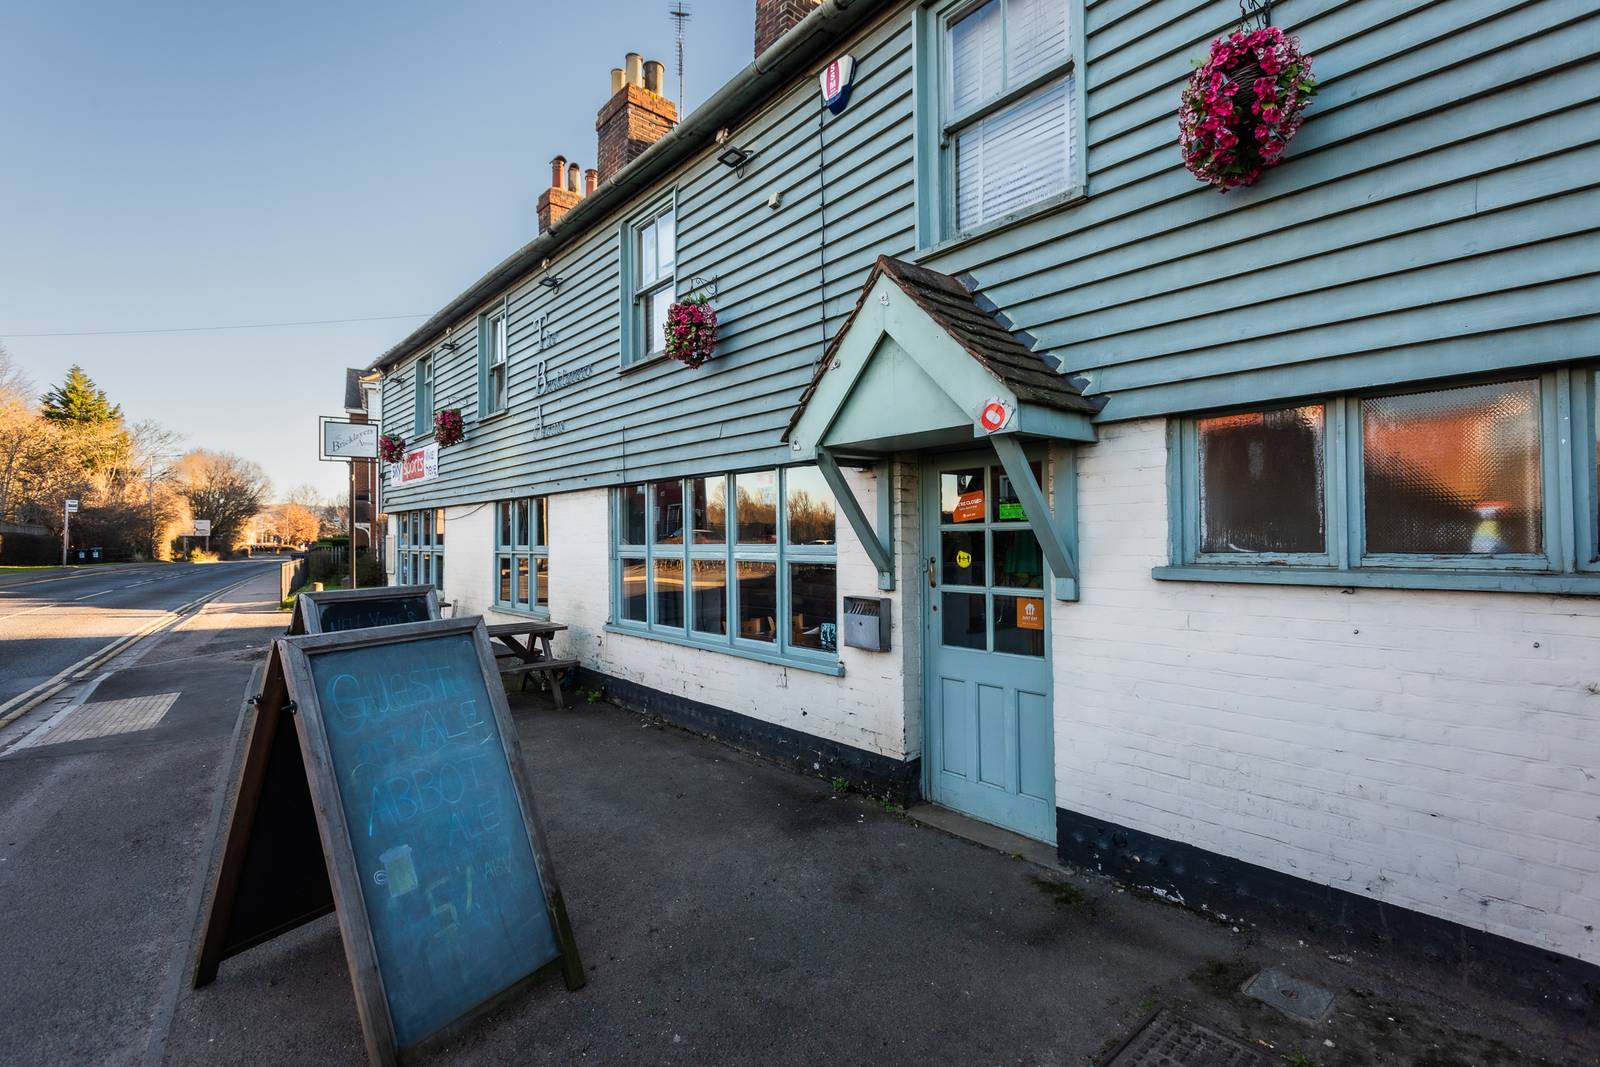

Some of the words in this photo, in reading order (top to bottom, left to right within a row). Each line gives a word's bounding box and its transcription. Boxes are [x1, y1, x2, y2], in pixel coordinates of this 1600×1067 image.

[403, 455, 424, 479] sports
[332, 666, 450, 718] GUEST
[421, 699, 485, 748] ALE
[368, 752, 487, 838] ABBOT
